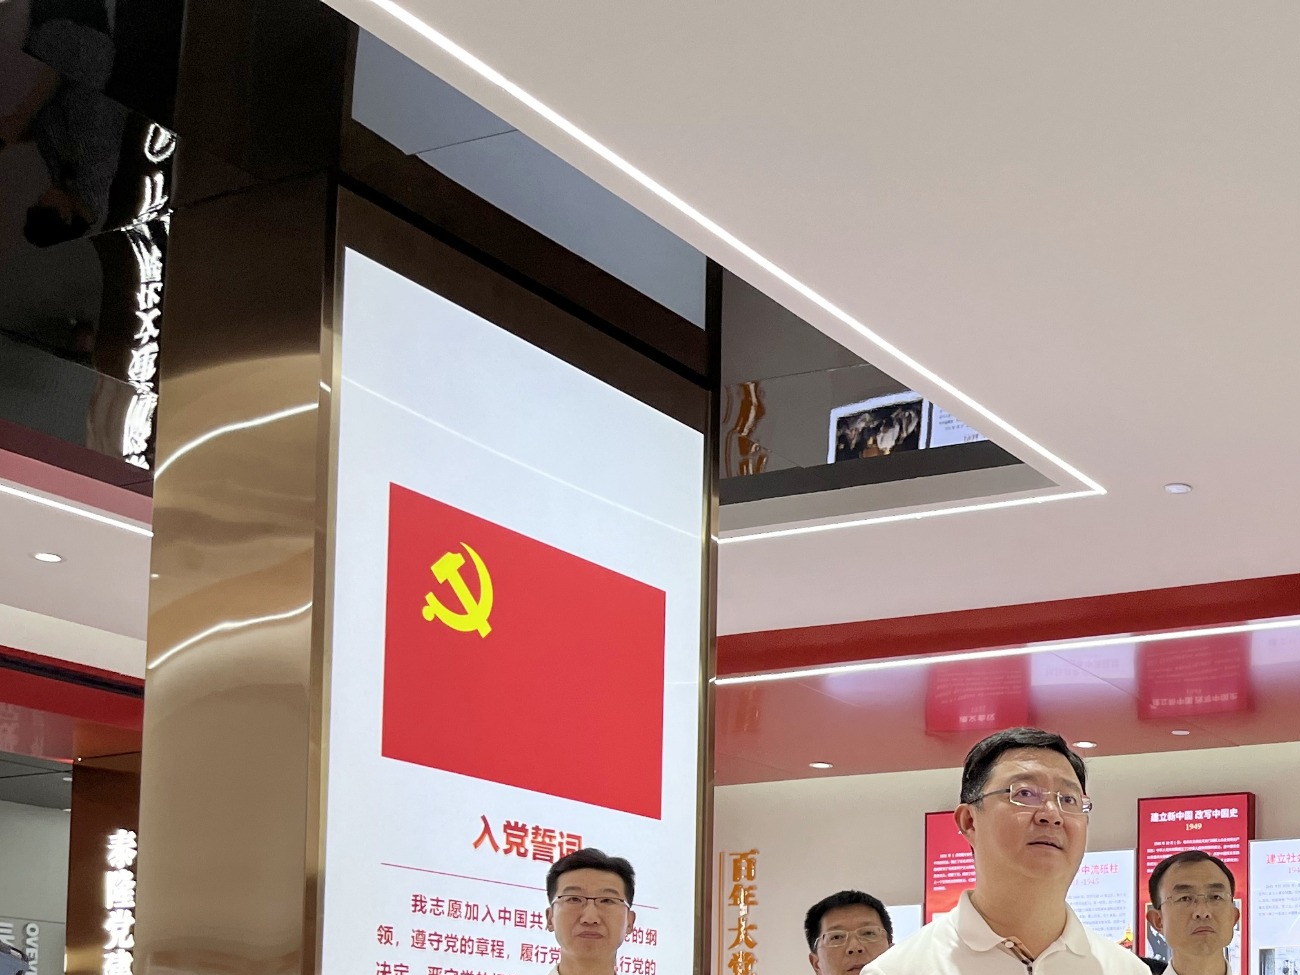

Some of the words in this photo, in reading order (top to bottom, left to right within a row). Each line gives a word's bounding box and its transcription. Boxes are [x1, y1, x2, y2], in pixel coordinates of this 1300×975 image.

[1150, 809, 1193, 822] 建立新中国
[1194, 808, 1239, 820] 改写中国史
[1185, 823, 1203, 831] 1949
[472, 814, 584, 864] 入党誓词
[614, 956, 656, 975] 行党的
